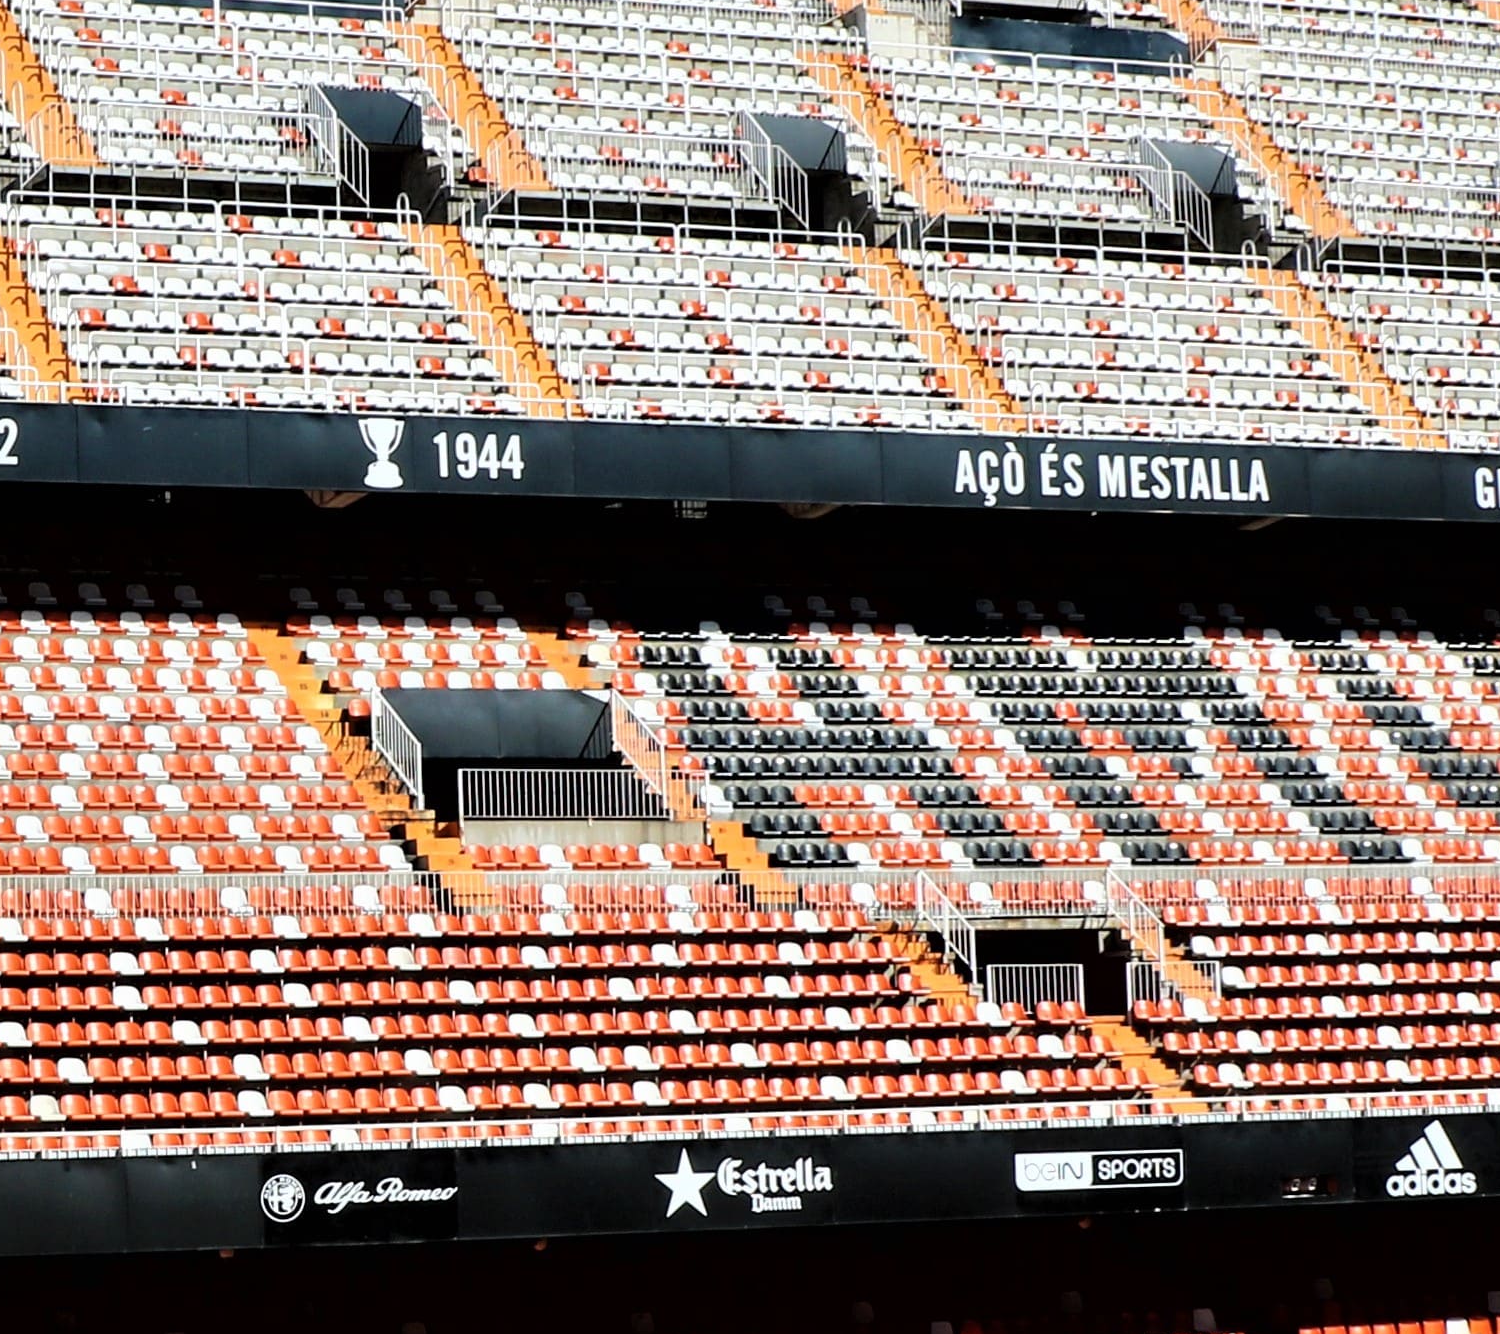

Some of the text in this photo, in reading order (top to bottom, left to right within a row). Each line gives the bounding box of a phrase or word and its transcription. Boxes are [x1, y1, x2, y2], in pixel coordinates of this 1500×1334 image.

[432, 431, 524, 480] 1944
[955, 442, 1270, 507] AÇÒ ÉS MESTALLA
[717, 1157, 833, 1195] Estrella
[1098, 1157, 1176, 1180] SPORTS
[1386, 1167, 1477, 1197] adidas
[314, 1181, 371, 1214] Alfa
[373, 1177, 458, 1203] Romeo
[750, 1193, 802, 1213] Damm
